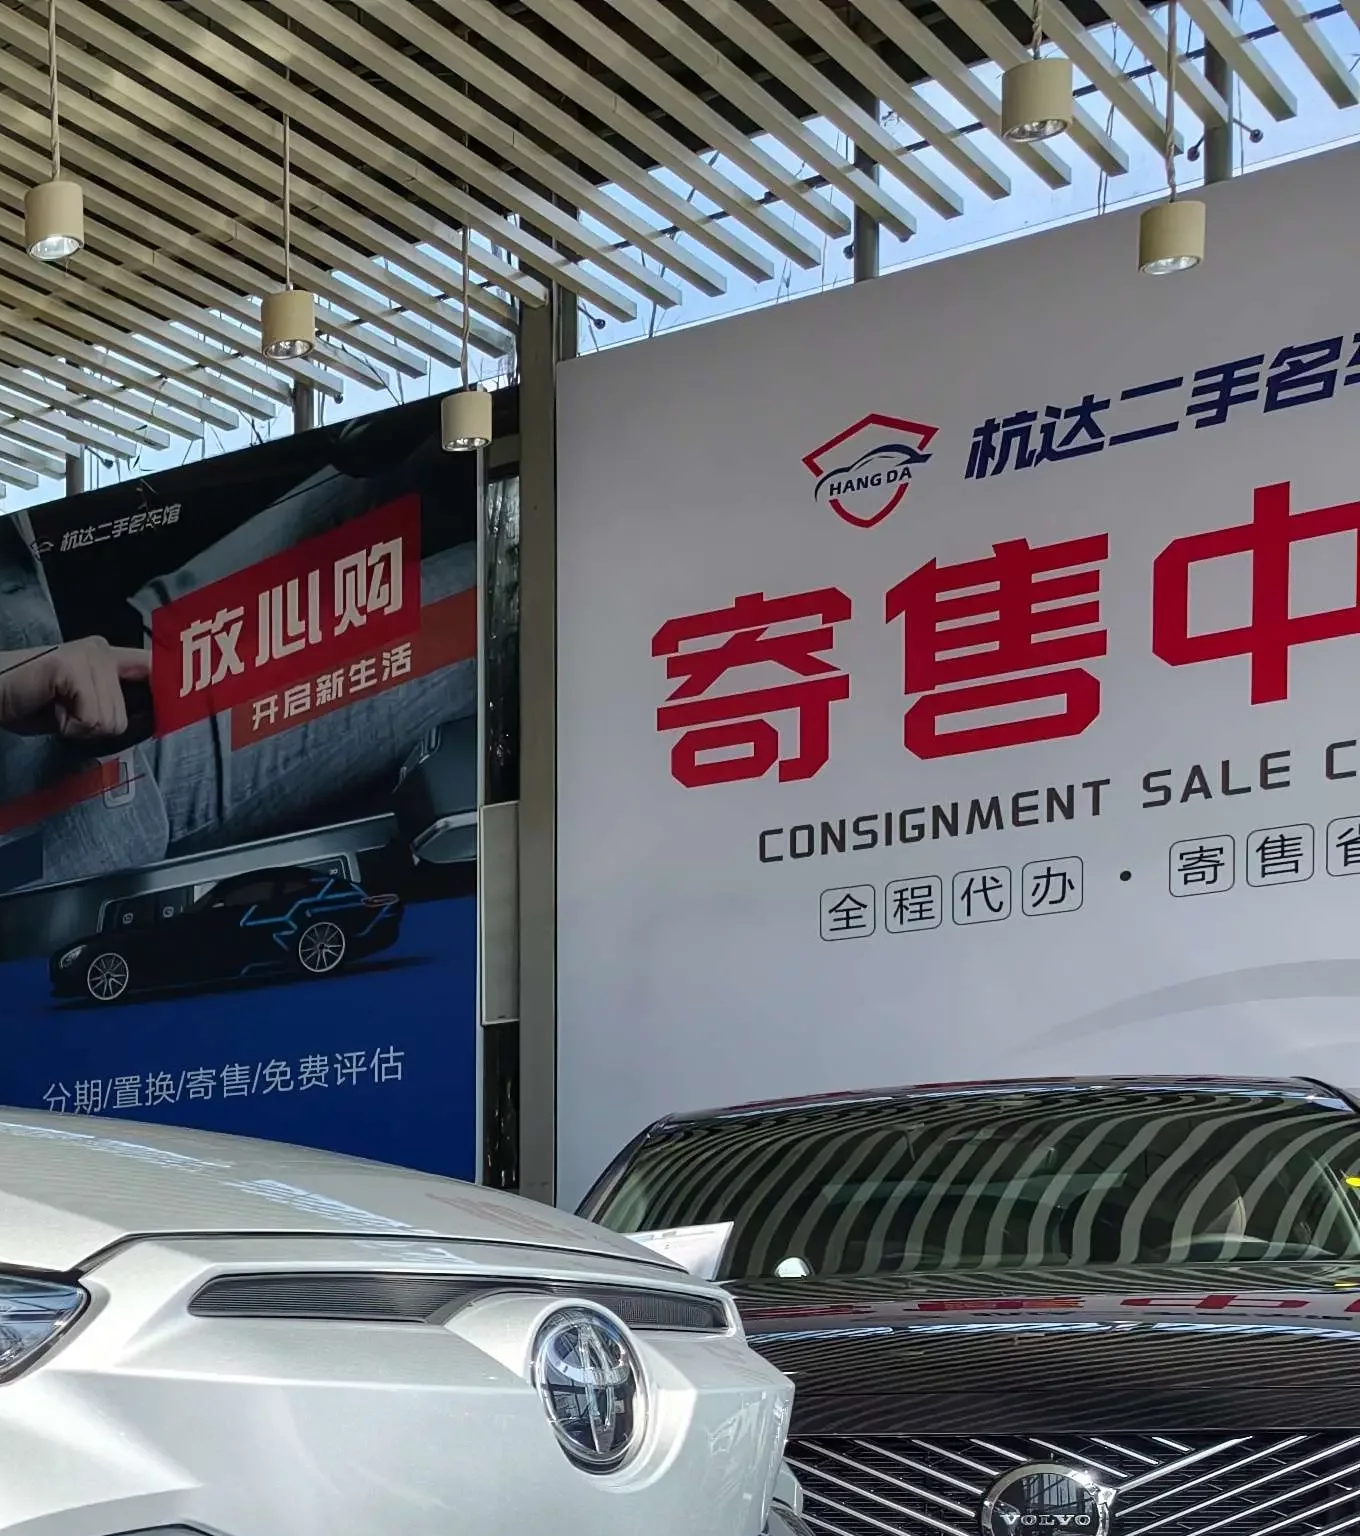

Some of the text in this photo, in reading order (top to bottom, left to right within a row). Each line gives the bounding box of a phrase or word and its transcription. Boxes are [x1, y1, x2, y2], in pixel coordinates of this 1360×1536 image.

[964, 331, 1360, 481] 杭达二手名
[827, 465, 914, 499] HANG DA
[60, 503, 182, 552] 杭达二手名车馆
[178, 538, 405, 698] 放心购
[652, 480, 1360, 789] 寄售中
[250, 642, 414, 732] 开启新生活
[759, 778, 1112, 864] CONSIGNMENT
[1142, 750, 1291, 809] SALE
[827, 864, 1076, 933] 全程代办
[998, 1512, 1092, 1527] VOLVO
